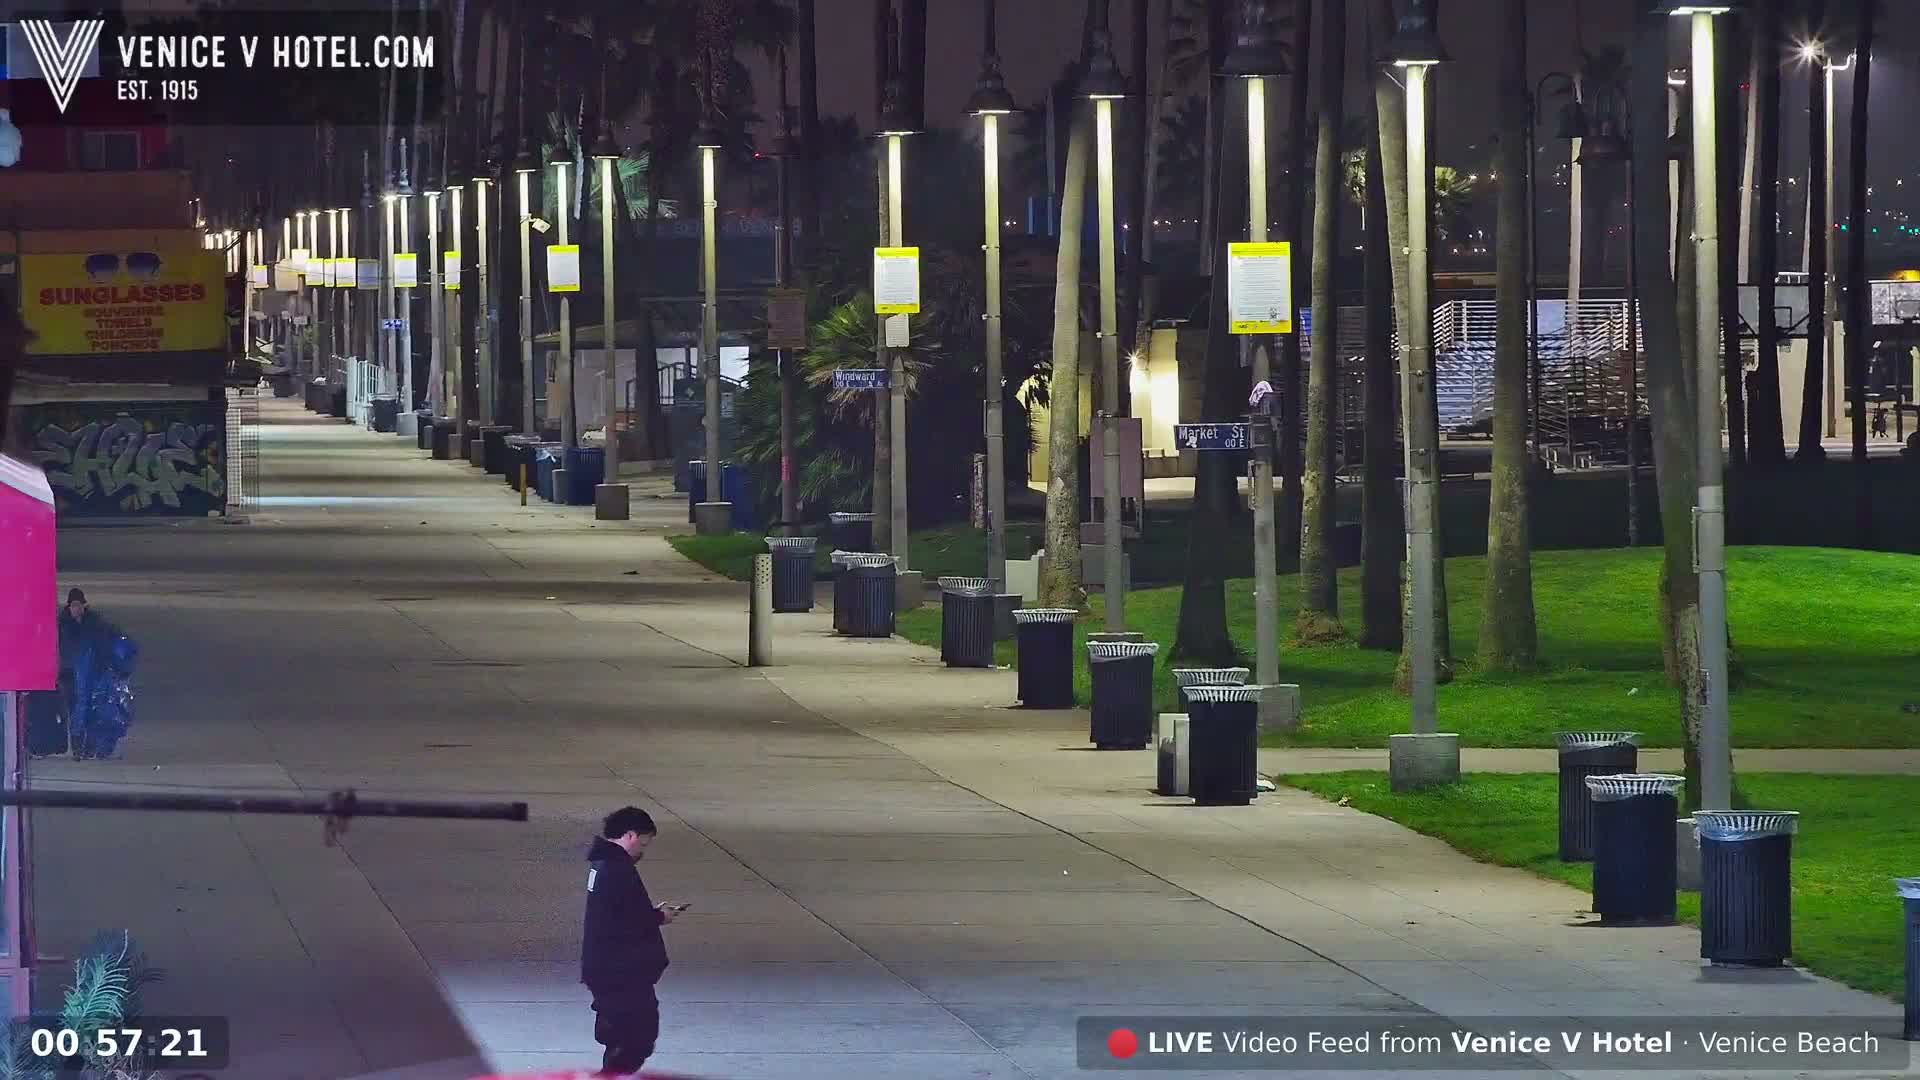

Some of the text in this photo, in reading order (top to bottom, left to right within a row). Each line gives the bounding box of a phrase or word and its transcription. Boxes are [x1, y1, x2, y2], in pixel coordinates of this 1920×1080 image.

[39, 285, 206, 305] SUNGLASSES
[95, 317, 153, 329] TOWELS
[836, 371, 876, 381] Windward
[1179, 426, 1245, 440] Market St
[1225, 438, 1244, 448] 00 E
